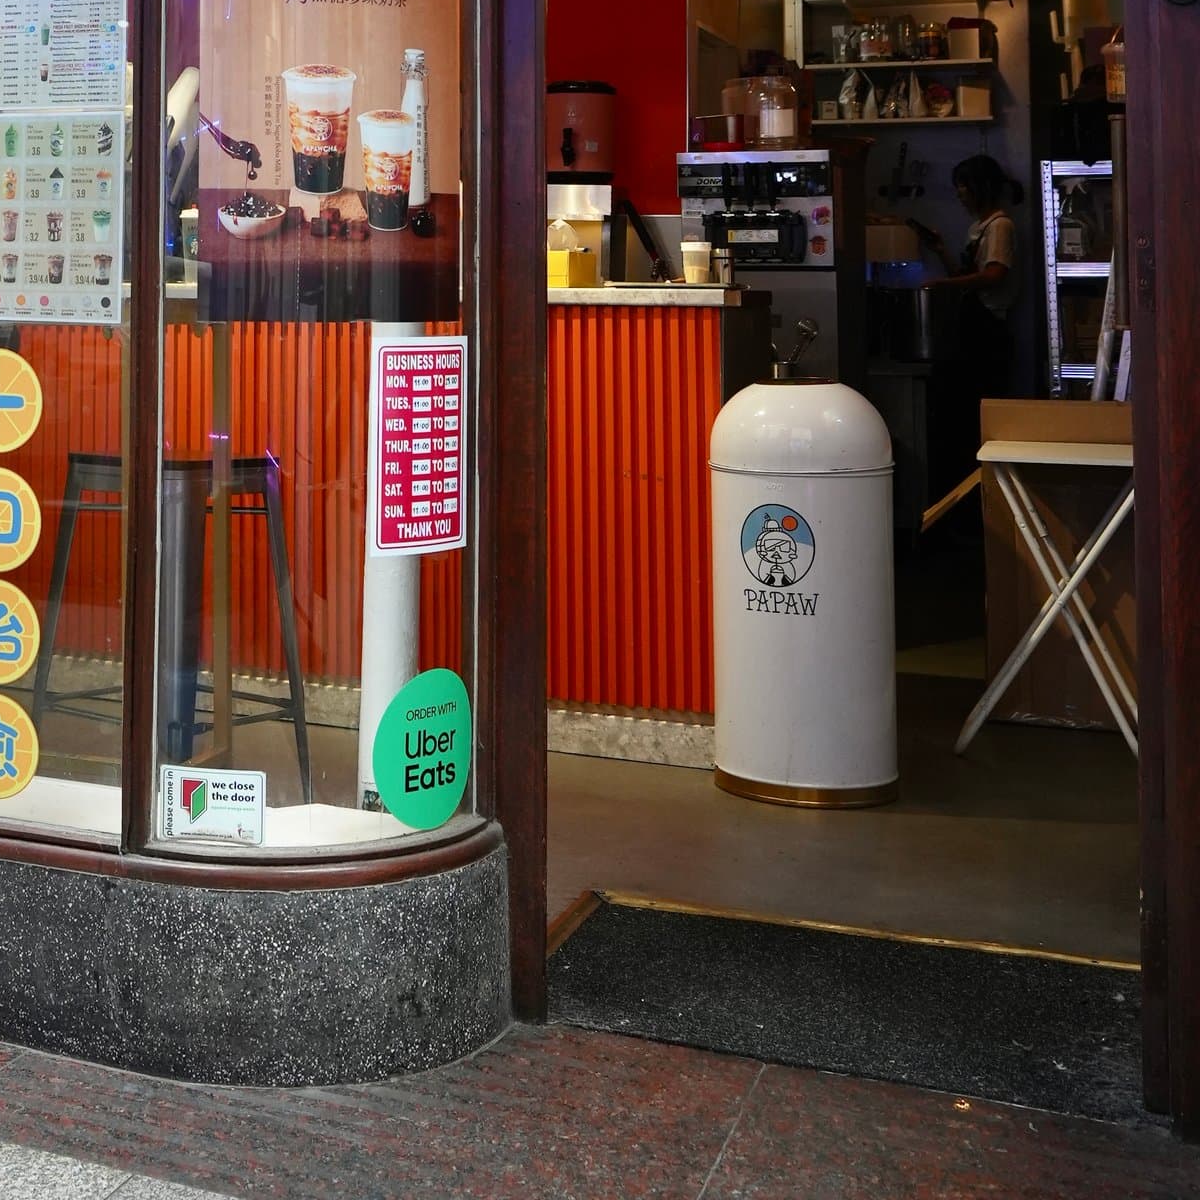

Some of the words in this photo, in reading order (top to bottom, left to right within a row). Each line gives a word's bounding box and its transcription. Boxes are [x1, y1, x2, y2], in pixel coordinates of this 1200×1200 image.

[386, 354, 434, 371] BUSINESS
[435, 353, 460, 369] HOURS
[386, 375, 408, 388] MON.
[433, 374, 443, 386] TO
[386, 397, 411, 410] TUES.
[433, 396, 443, 408] TO
[385, 418, 407, 432] WED.
[433, 417, 443, 430] TO
[385, 439, 412, 453] THUR.
[432, 438, 443, 451] TO
[385, 462, 402, 475] FRI.
[432, 459, 443, 472] TO
[385, 484, 403, 497] SAT.
[432, 481, 443, 493] TO
[384, 506, 405, 519] SUN.
[432, 502, 442, 514] TO
[397, 521, 433, 539] THANK
[434, 519, 451, 536] YOU
[743, 588, 820, 616] PAPAW
[406, 704, 437, 722] ORDER
[438, 701, 457, 715] WITH
[404, 726, 457, 760] Uber
[167, 770, 174, 780] in
[404, 760, 457, 793] Eats
[228, 780, 255, 791] close
[212, 792, 229, 801] the
[231, 793, 256, 802] door
[165, 807, 174, 836] please
